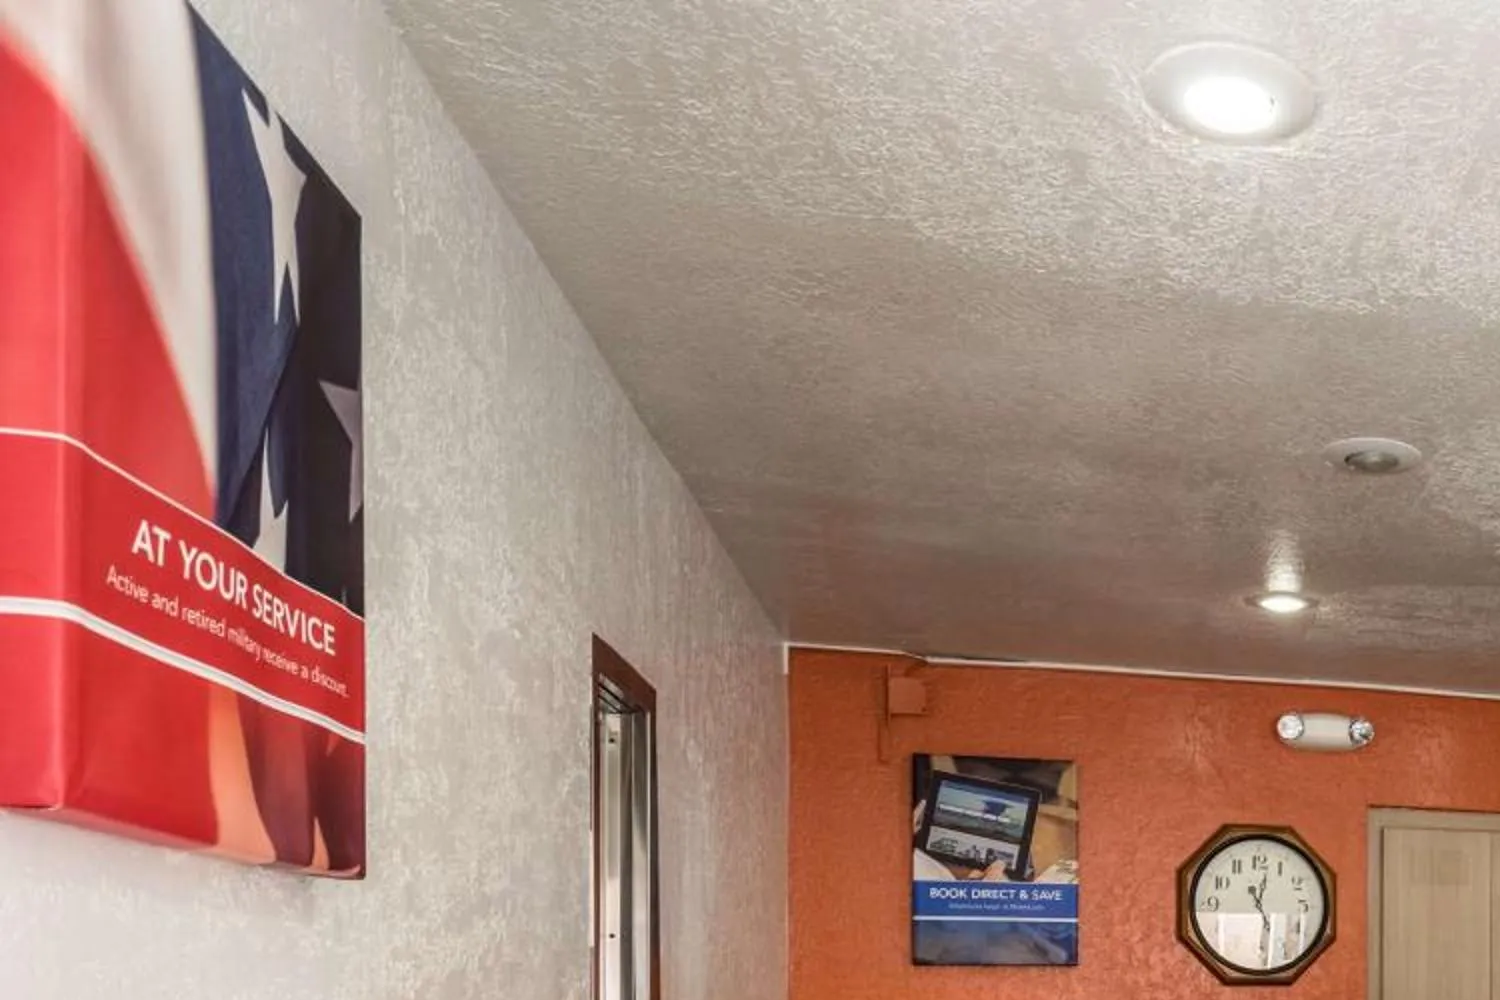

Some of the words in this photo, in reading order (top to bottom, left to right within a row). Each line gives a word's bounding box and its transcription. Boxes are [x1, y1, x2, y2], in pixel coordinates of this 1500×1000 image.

[132, 519, 172, 567] AT
[179, 539, 248, 609] YOUR
[252, 583, 336, 656] SERVICE
[106, 564, 149, 603] Active
[151, 593, 179, 617] and
[181, 608, 226, 637] retired
[227, 627, 261, 661] military
[301, 664, 309, 679] a
[1252, 855, 1269, 871] 12
[1215, 876, 1230, 890] 10
[929, 887, 968, 900] BOOK
[971, 888, 1017, 900] DIRECT
[1031, 889, 1063, 901] SAVE
[1207, 896, 1220, 912] 9
